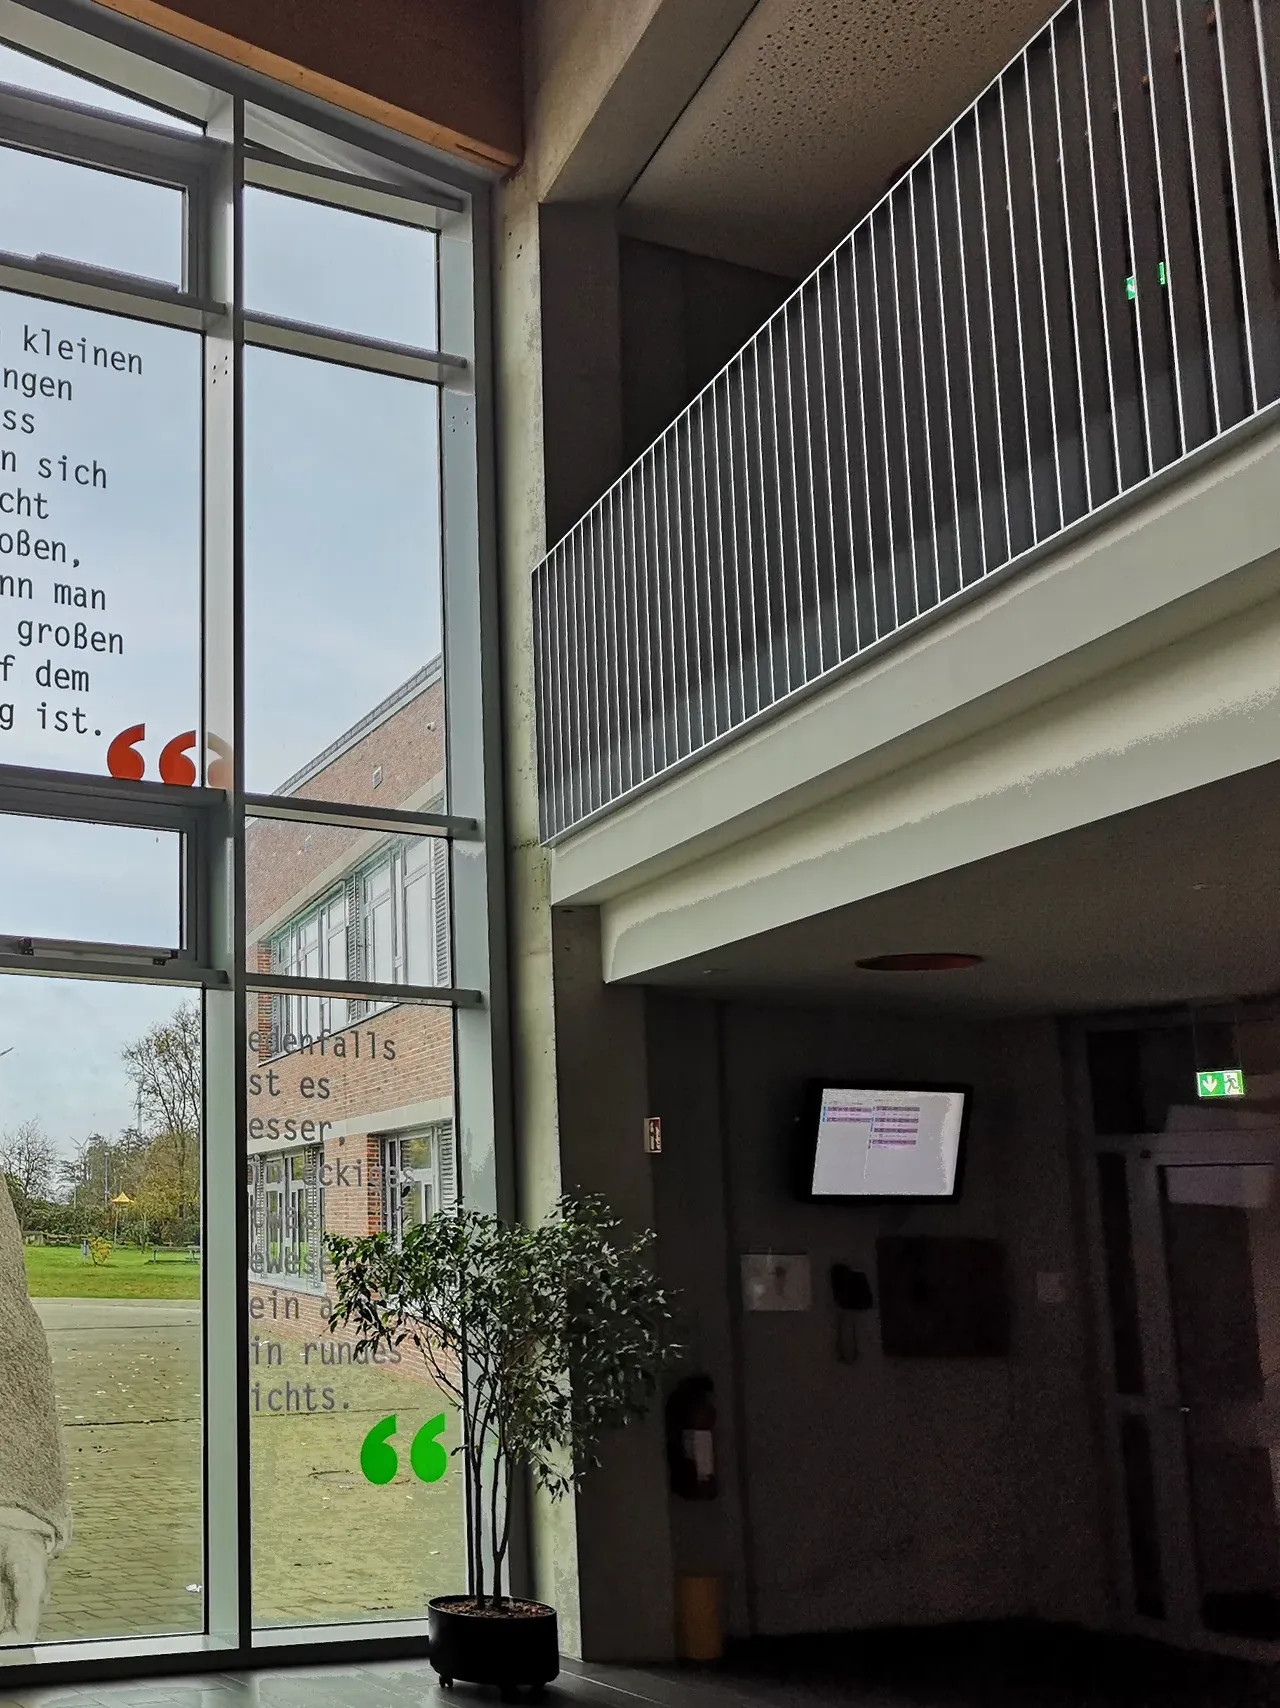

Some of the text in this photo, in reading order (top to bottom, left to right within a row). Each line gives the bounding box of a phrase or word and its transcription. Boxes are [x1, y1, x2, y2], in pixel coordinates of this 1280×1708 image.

[23, 325, 143, 375] kleinen
[37, 455, 107, 489] sich
[53, 581, 107, 611] man
[17, 619, 124, 655] großen
[35, 659, 89, 693] dem
[36, 701, 102, 737] ist.
[248, 1028, 396, 1061] edenfalls
[249, 1069, 331, 1099] st es
[249, 1117, 345, 1147] esser,
[249, 1289, 300, 1320] ein
[251, 1335, 282, 1365] in
[251, 1381, 349, 1412] ichts.
